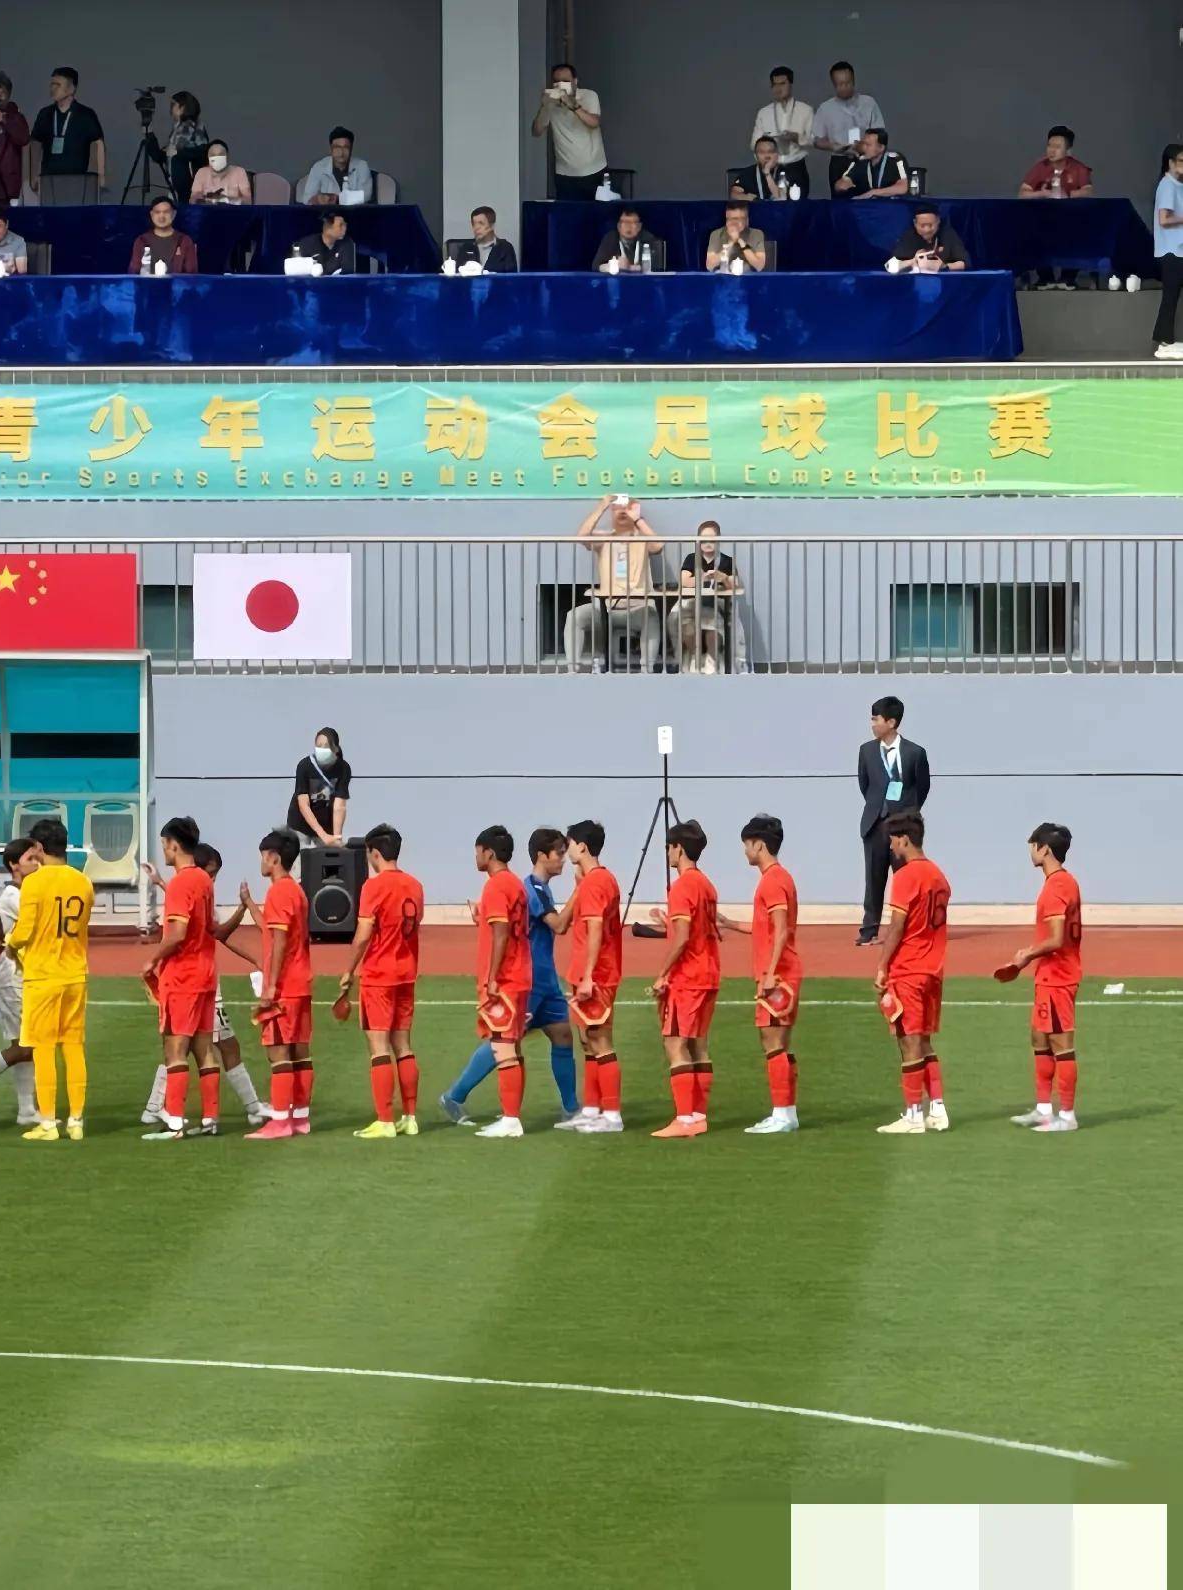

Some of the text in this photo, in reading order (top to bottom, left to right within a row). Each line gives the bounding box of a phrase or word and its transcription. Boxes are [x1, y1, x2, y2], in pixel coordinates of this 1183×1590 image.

[78, 466, 209, 489] Sports
[234, 465, 415, 489] Exchange
[439, 464, 525, 487] Meet
[552, 465, 716, 487] Football
[743, 463, 987, 489] Competition
[55, 896, 84, 938] 12
[401, 898, 417, 936] 8
